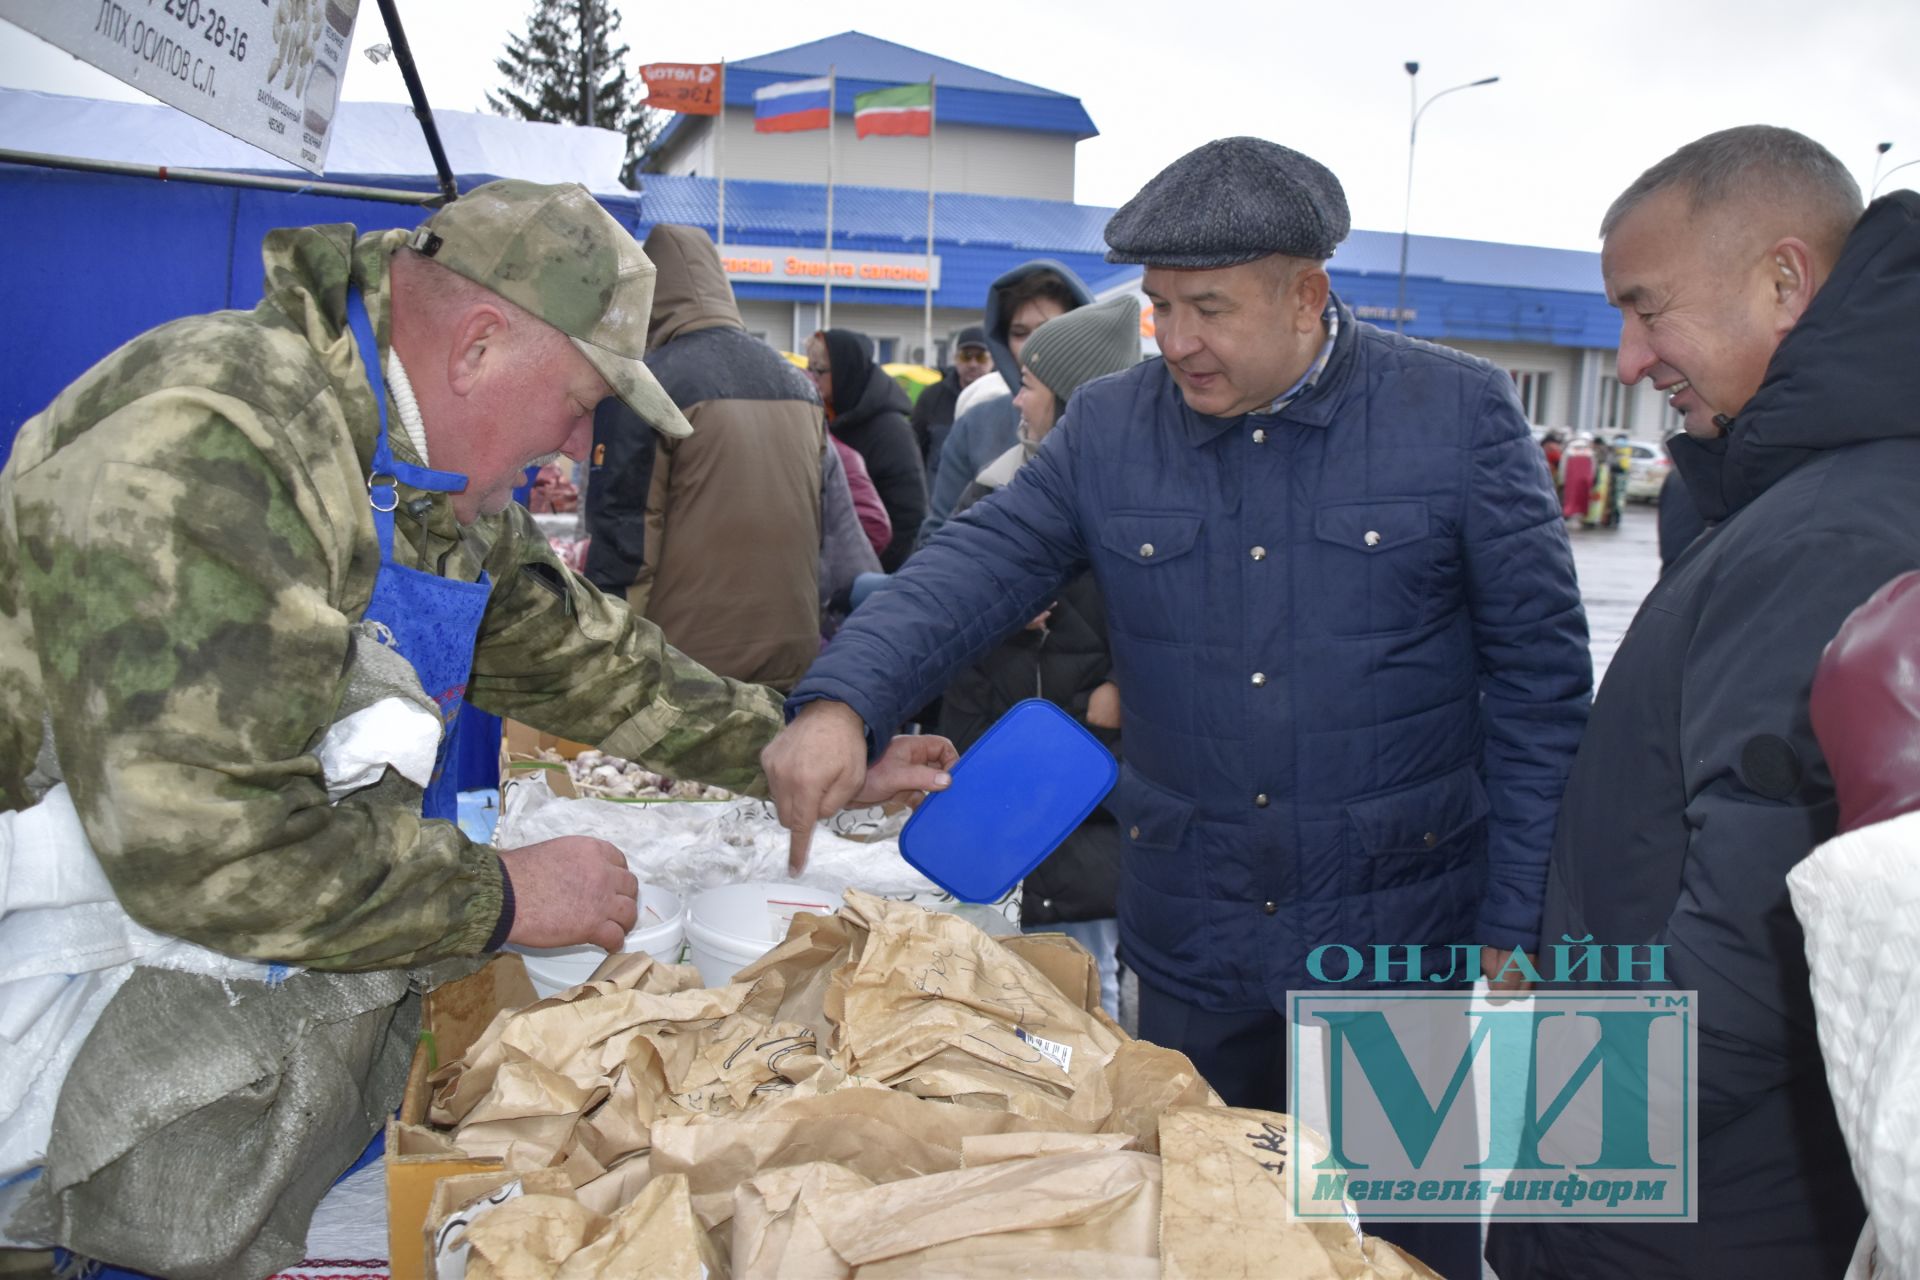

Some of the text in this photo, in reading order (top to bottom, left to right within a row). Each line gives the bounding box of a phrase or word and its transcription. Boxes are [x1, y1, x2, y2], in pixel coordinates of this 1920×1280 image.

[95, 0, 216, 98] ЛПХ ОСИПОВ С.Л.
[268, 117, 286, 135] ЧЕСНОК
